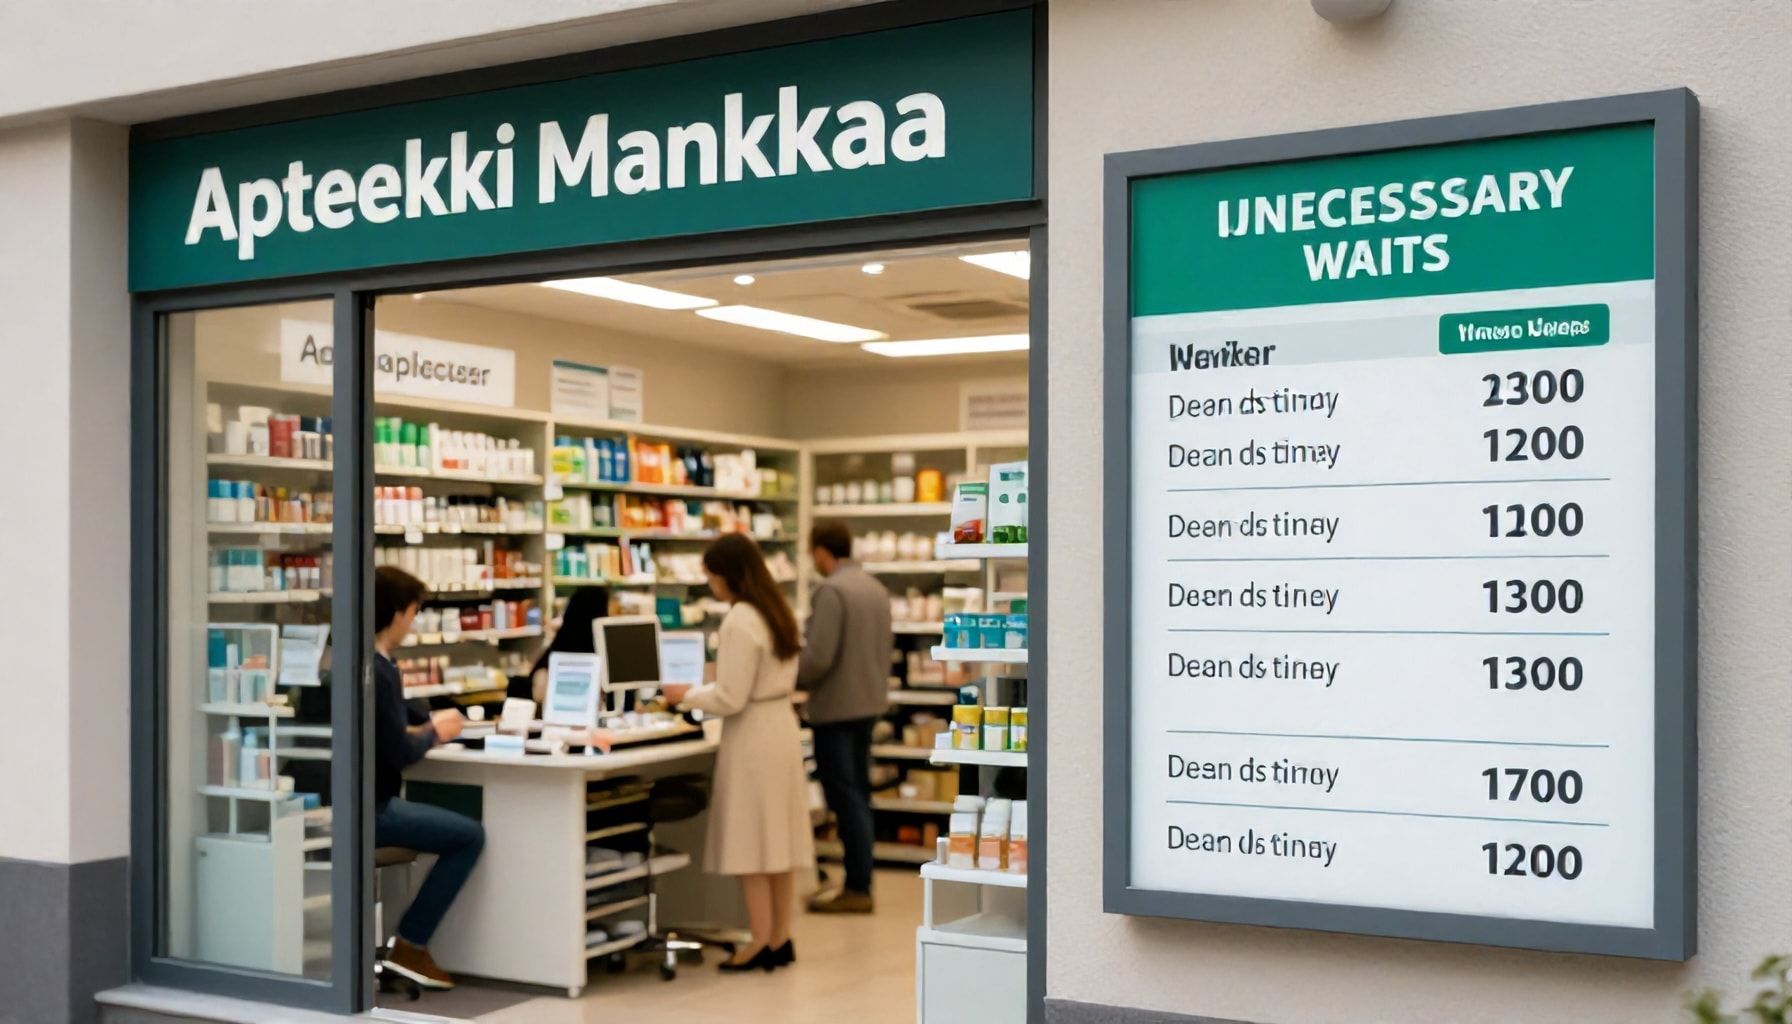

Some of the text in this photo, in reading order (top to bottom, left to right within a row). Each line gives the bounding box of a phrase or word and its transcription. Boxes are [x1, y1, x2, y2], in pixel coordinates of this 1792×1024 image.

[184, 85, 947, 262] Apteekki Mankkaa
[1302, 233, 1451, 282] WAITS
[1481, 367, 1585, 408] 2300
[1168, 394, 1233, 419] Dean
[1168, 443, 1233, 468] Dean
[1482, 424, 1585, 463] 1200
[1168, 514, 1233, 538] Dean
[1482, 501, 1584, 538] 1200
[1482, 578, 1584, 615] 1300
[1168, 652, 1233, 678] Dean
[1482, 656, 1584, 692] 1300
[1481, 767, 1584, 805] 1700
[1168, 825, 1232, 853] Dean
[1481, 842, 1584, 881] 1200
